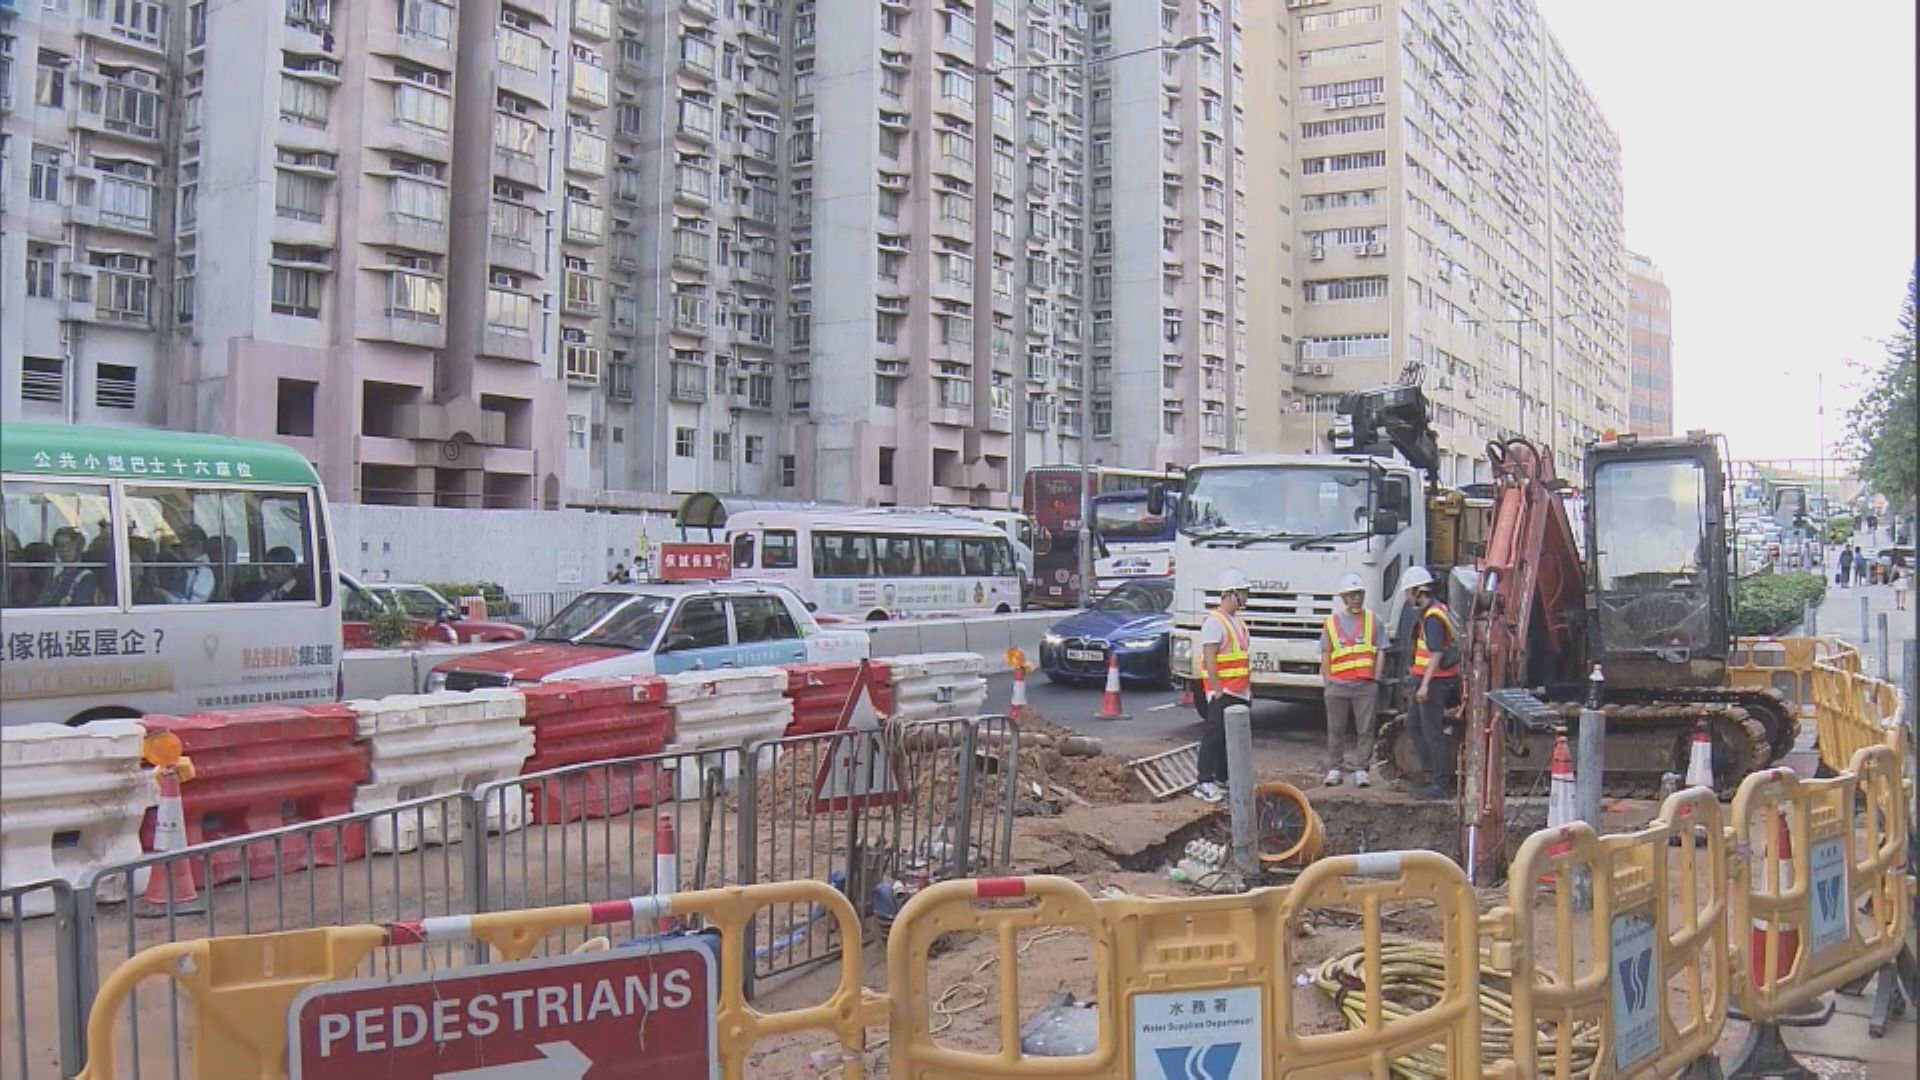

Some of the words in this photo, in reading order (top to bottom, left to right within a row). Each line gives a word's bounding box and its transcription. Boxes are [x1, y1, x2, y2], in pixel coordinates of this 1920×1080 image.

[33, 450, 253, 478] 公共小型巴士十六座位
[1248, 580, 1290, 591] SUZU
[1, 627, 165, 662] 傢俬返屋企?
[318, 967, 693, 1058] PEDESTRIANS
[1168, 998, 1227, 1016] 水務署
[1143, 1023, 1167, 1034] Water
[1168, 1020, 1204, 1032] Supplies
[1205, 1016, 1254, 1029] Department
